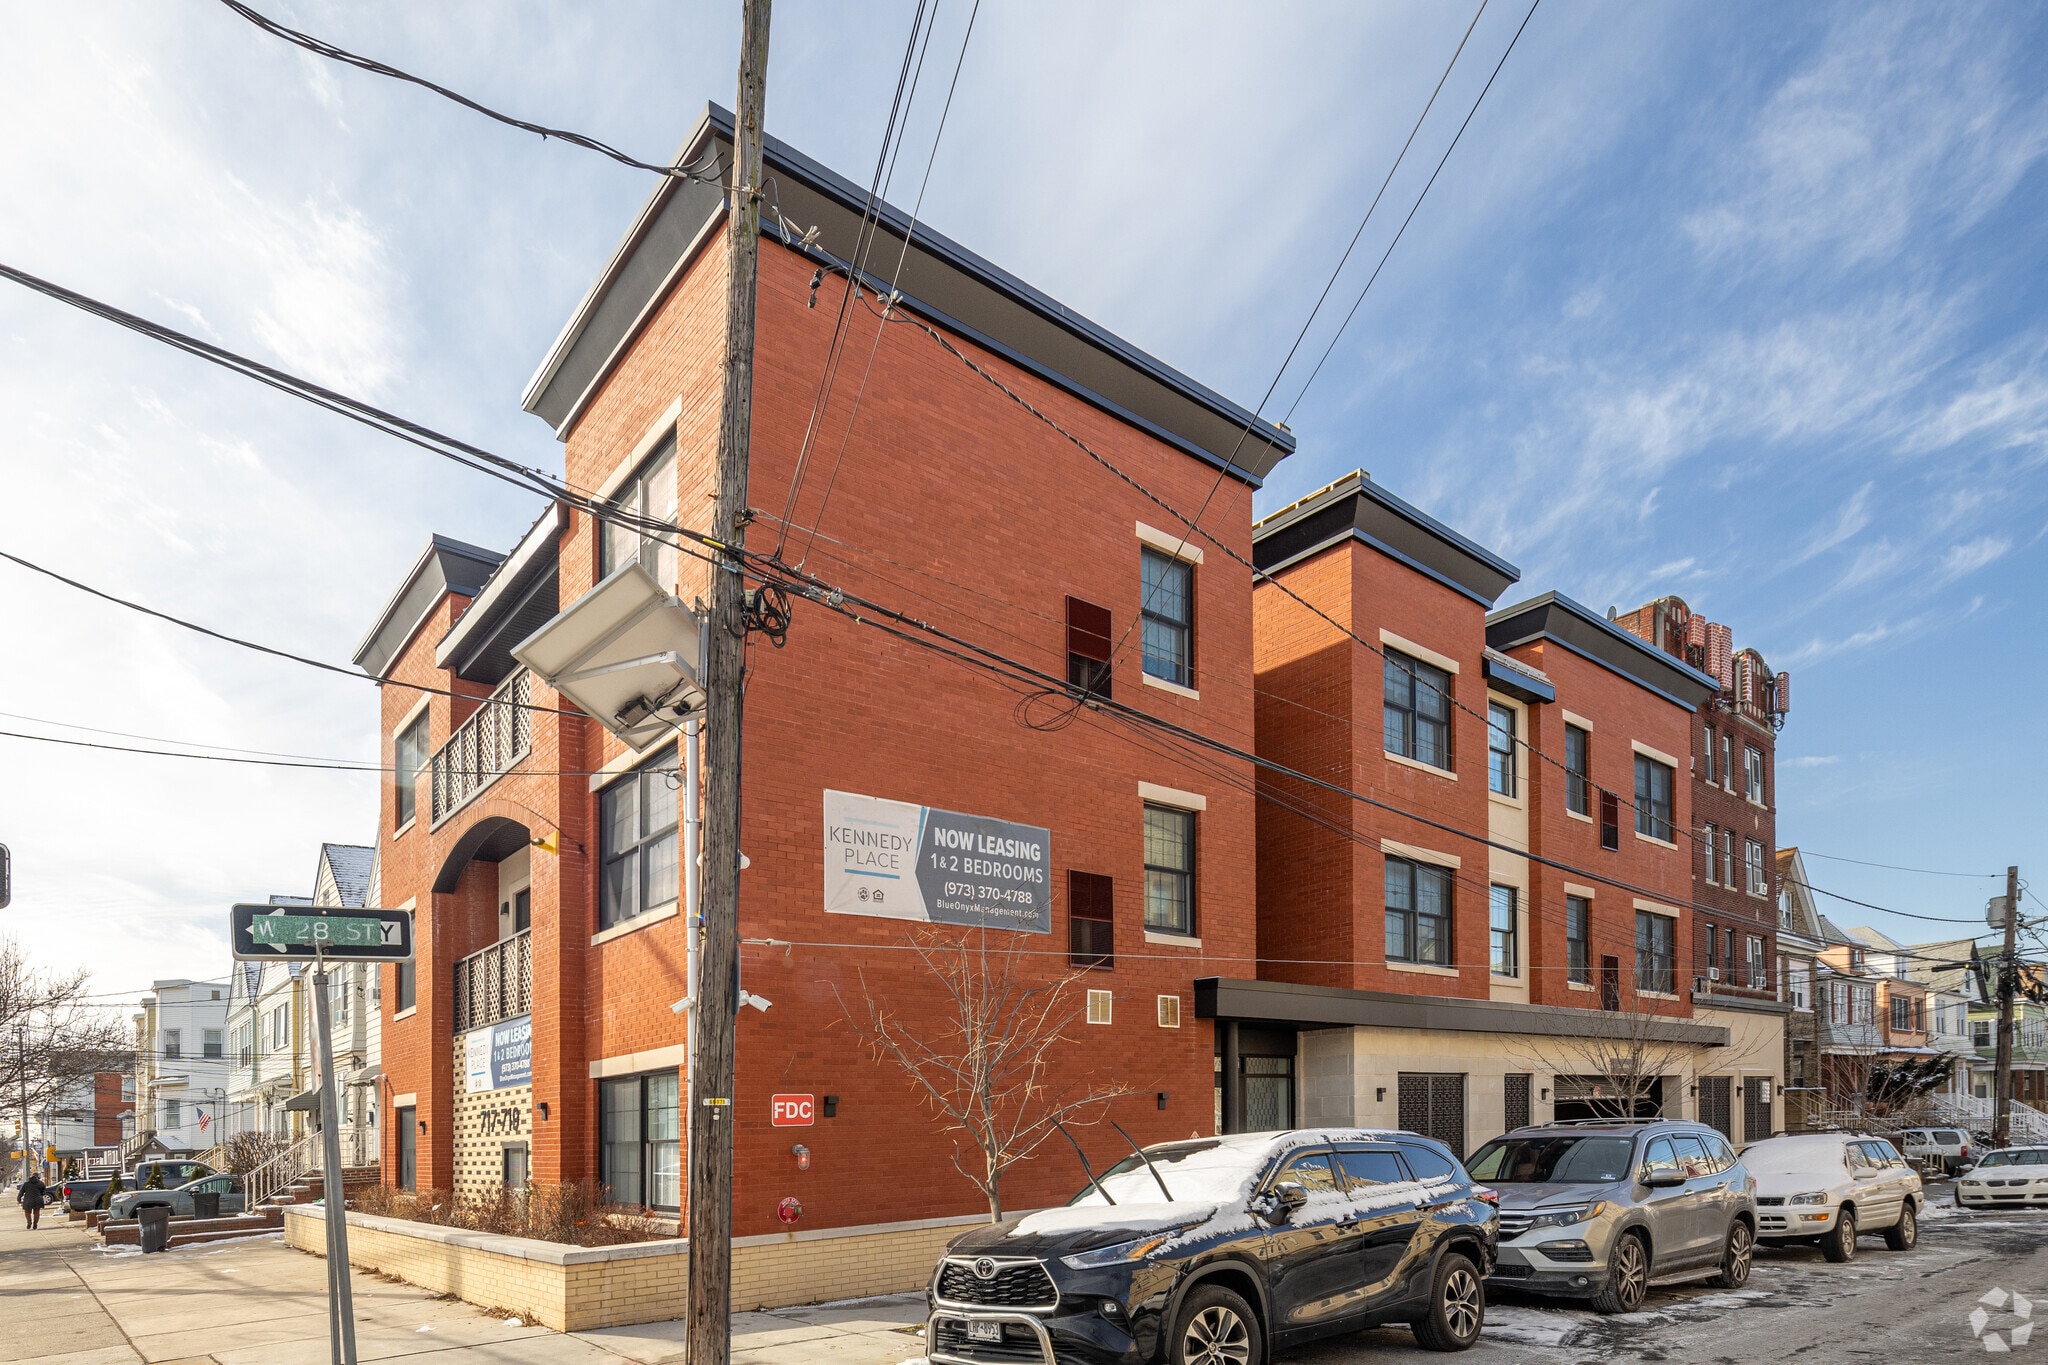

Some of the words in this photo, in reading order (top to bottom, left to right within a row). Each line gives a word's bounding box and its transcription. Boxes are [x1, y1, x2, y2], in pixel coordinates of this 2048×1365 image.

[829, 826, 913, 852] KENNEDY
[934, 827, 975, 851] NOW
[978, 834, 1041, 861] LEASING
[844, 848, 900, 869] PLACE
[963, 857, 1044, 884] BEDROOMS
[944, 881, 975, 900] (973)
[978, 885, 1033, 904] 370-4788
[936, 899, 1040, 919] BlueOnyxManagement.com
[258, 920, 277, 938] W
[295, 922, 329, 940] 28
[346, 923, 376, 941] ST
[496, 1030, 510, 1047] NOW
[506, 1041, 532, 1060] BEDROO
[774, 1101, 812, 1119] FDC
